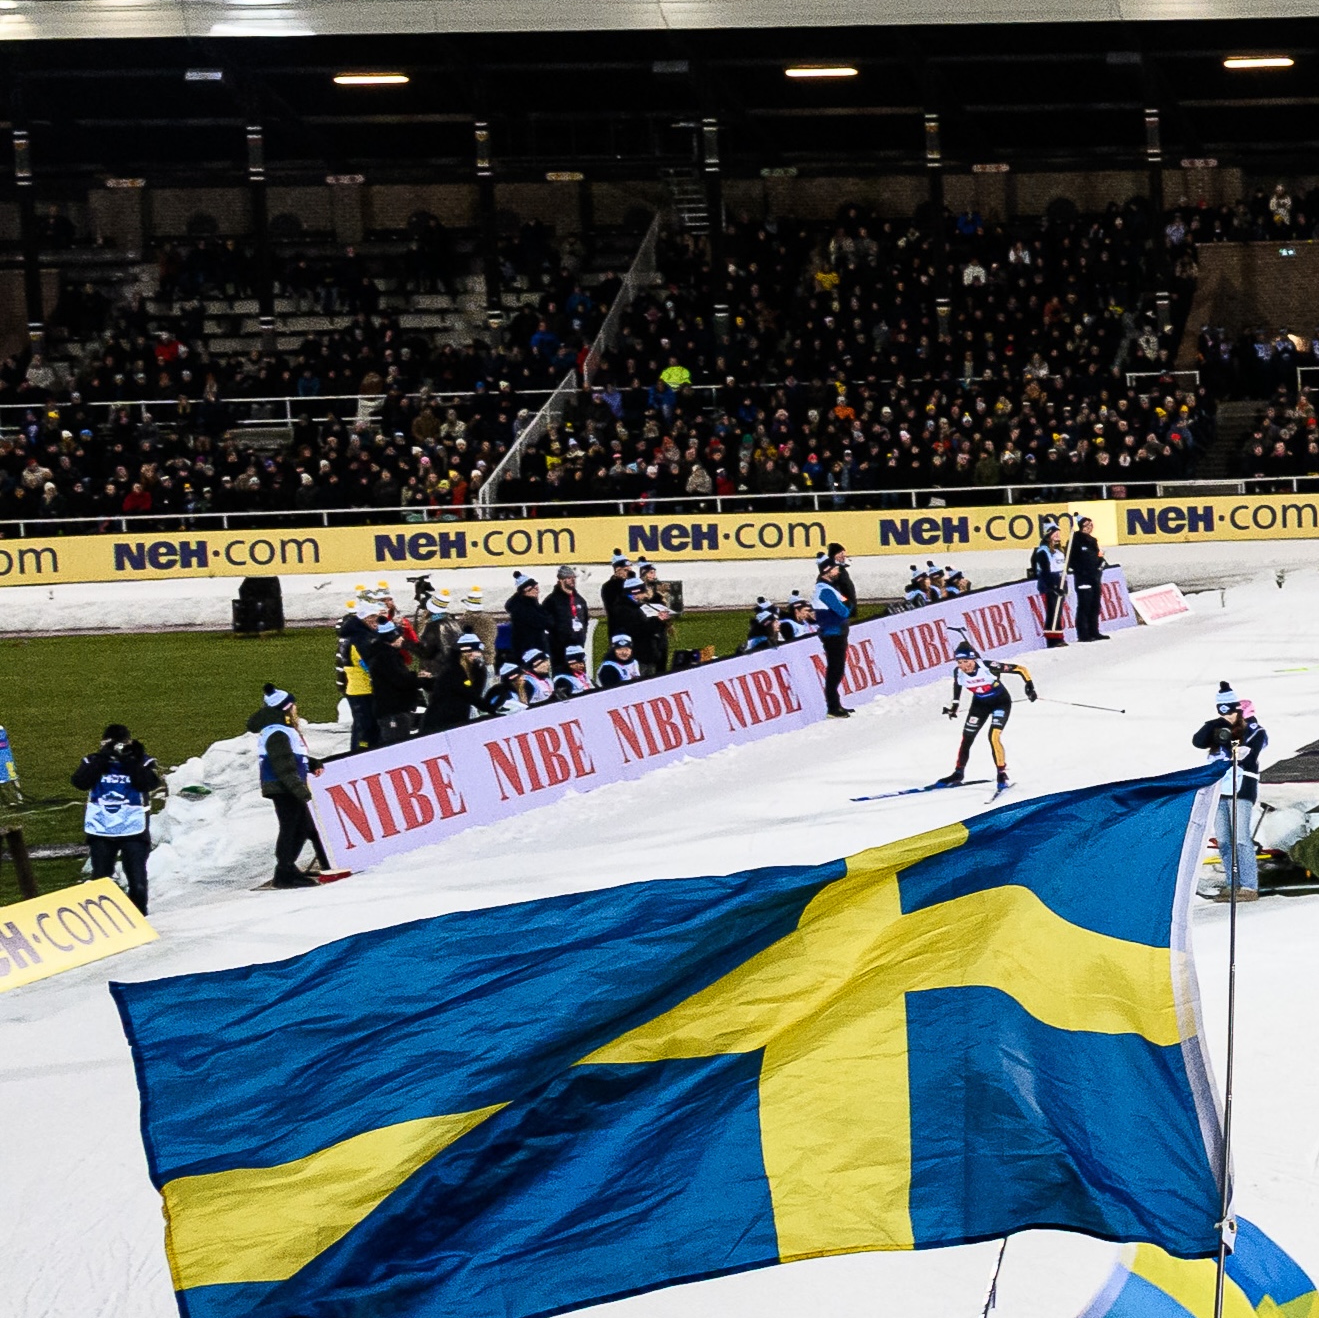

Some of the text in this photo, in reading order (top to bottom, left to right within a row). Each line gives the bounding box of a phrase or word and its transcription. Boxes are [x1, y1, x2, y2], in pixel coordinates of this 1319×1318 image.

[325, 754, 467, 850] NIBE
[483, 719, 596, 801] NIBE
[607, 690, 704, 764] NIBE
[714, 663, 803, 732] NIBE
[889, 618, 956, 677] NIBE
[962, 601, 1023, 653] NIBE
